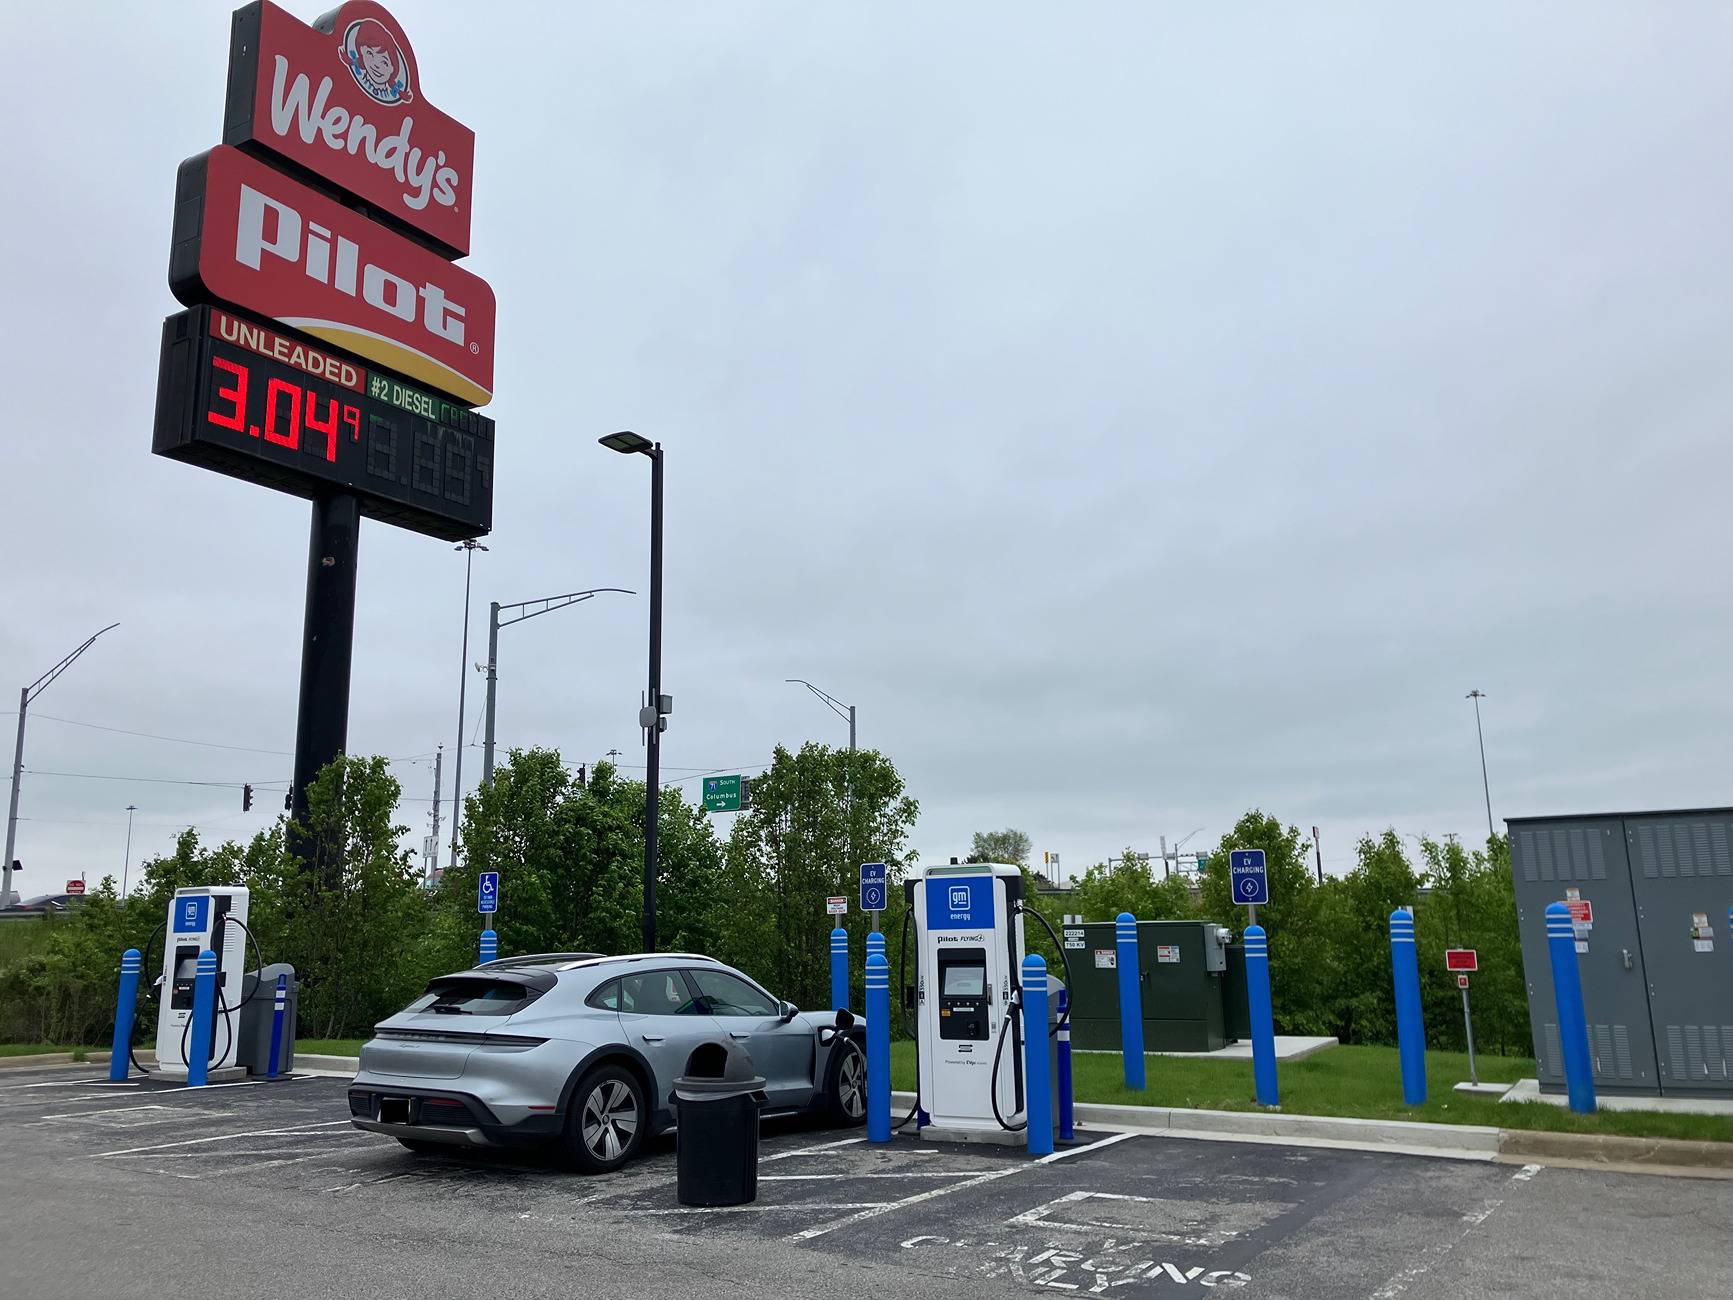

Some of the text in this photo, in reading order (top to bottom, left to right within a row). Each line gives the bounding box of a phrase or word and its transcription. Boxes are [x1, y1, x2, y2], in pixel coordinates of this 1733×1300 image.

[271, 54, 459, 211] Wendy's
[218, 315, 358, 388] UNLEADED
[371, 376, 436, 420] #2 DIESEL
[1243, 858, 1251, 866] EV
[1232, 866, 1264, 874] CHARGING
[862, 877, 885, 885] CHARGING
[952, 892, 967, 905] gm
[950, 913, 971, 921] energy
